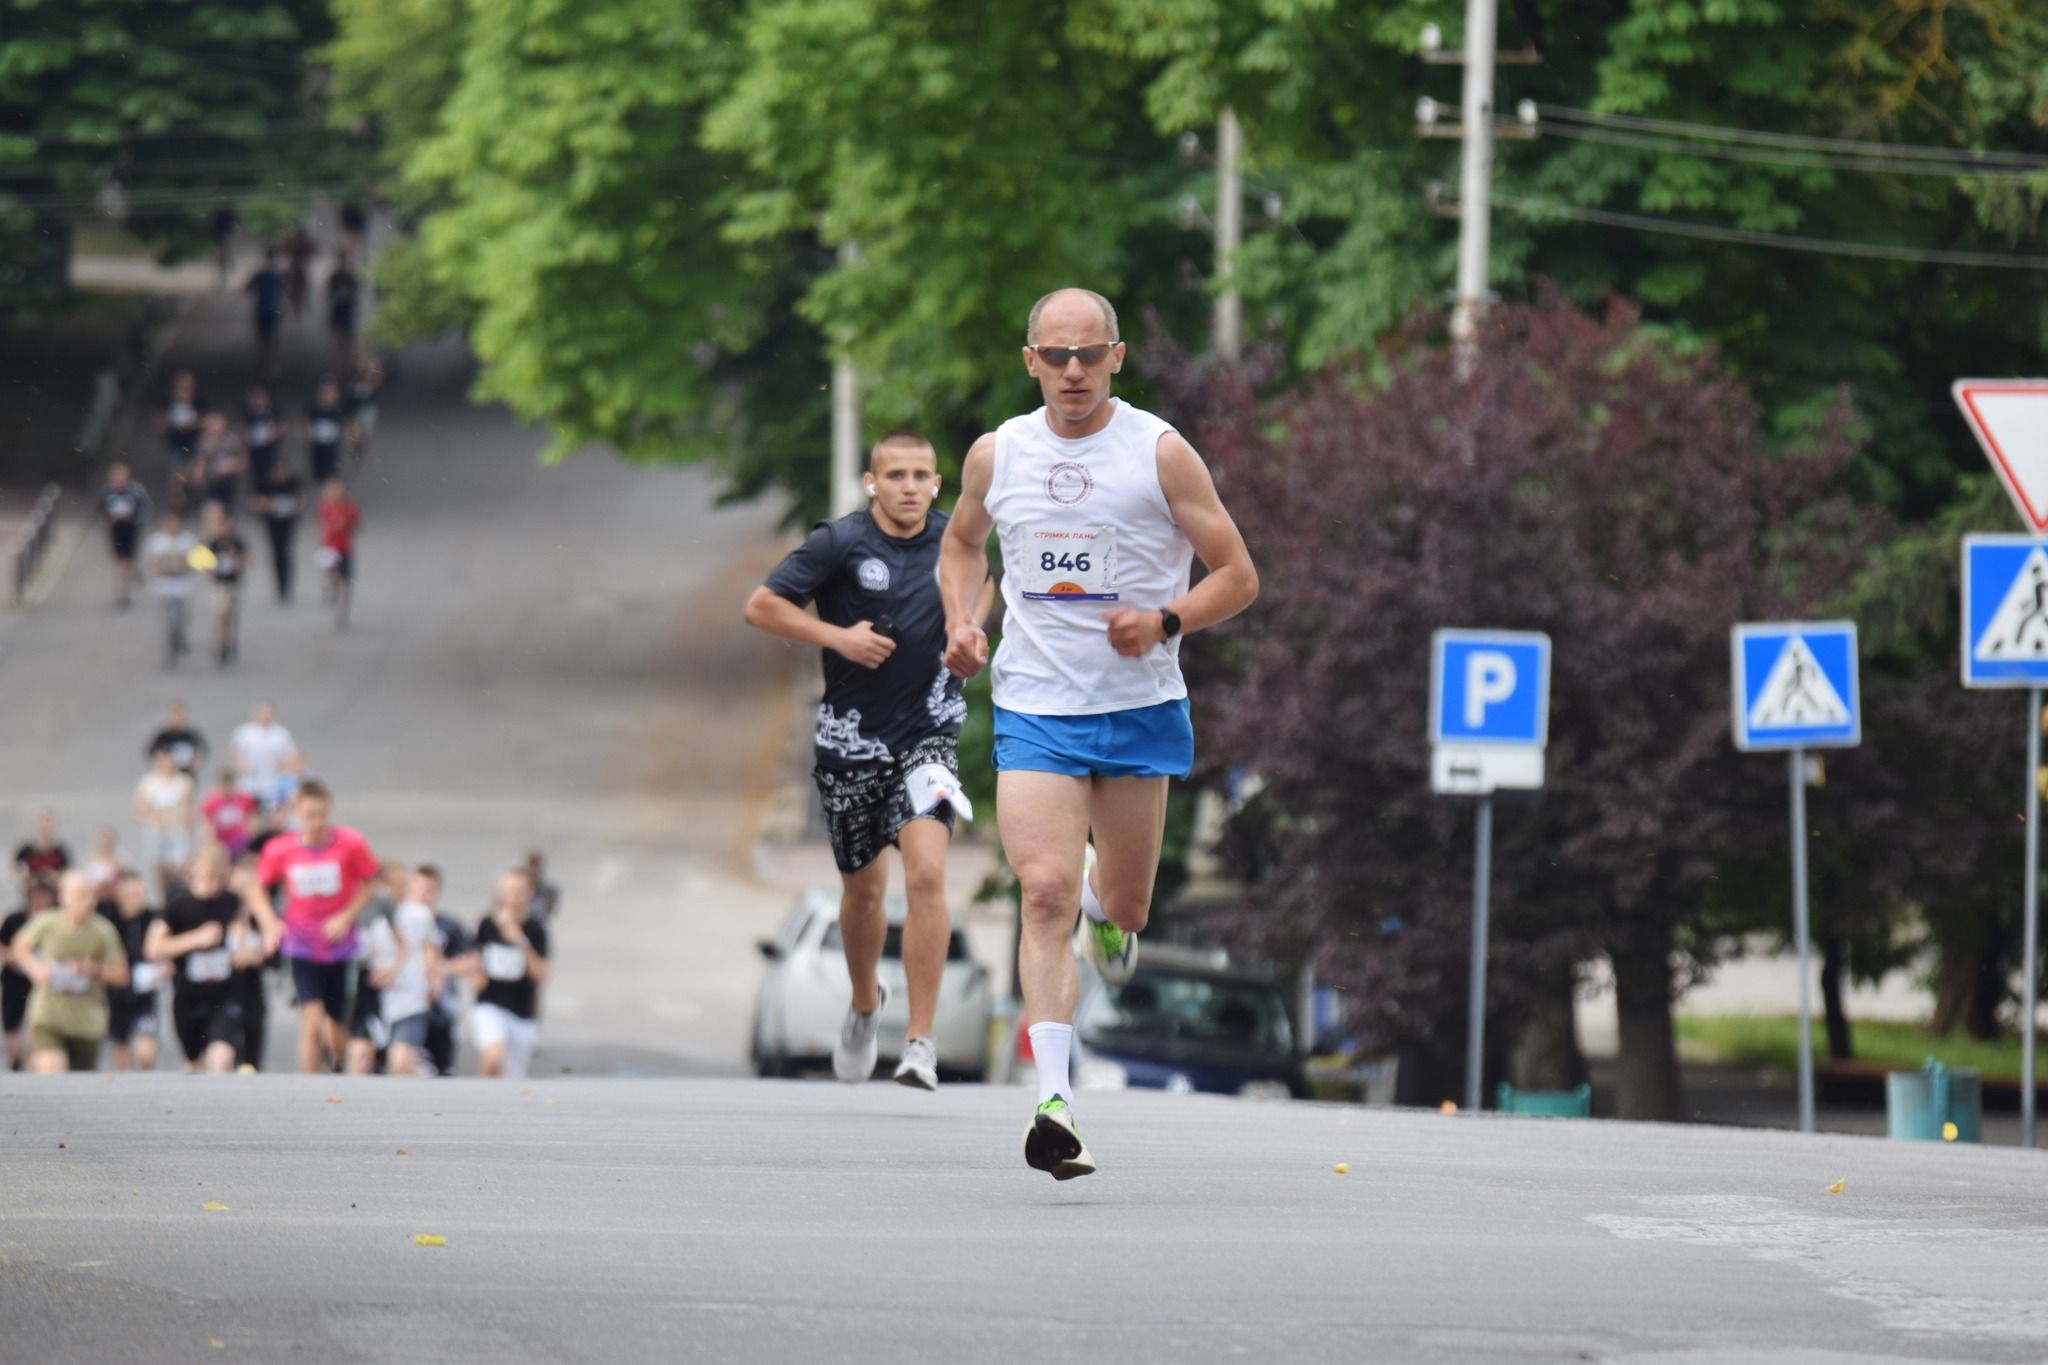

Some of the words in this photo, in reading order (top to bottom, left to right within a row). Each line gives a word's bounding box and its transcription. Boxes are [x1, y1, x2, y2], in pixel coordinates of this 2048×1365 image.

[1034, 531, 1070, 540] СТРІМКА
[1040, 551, 1092, 573] 846
[1464, 650, 1518, 729] P
